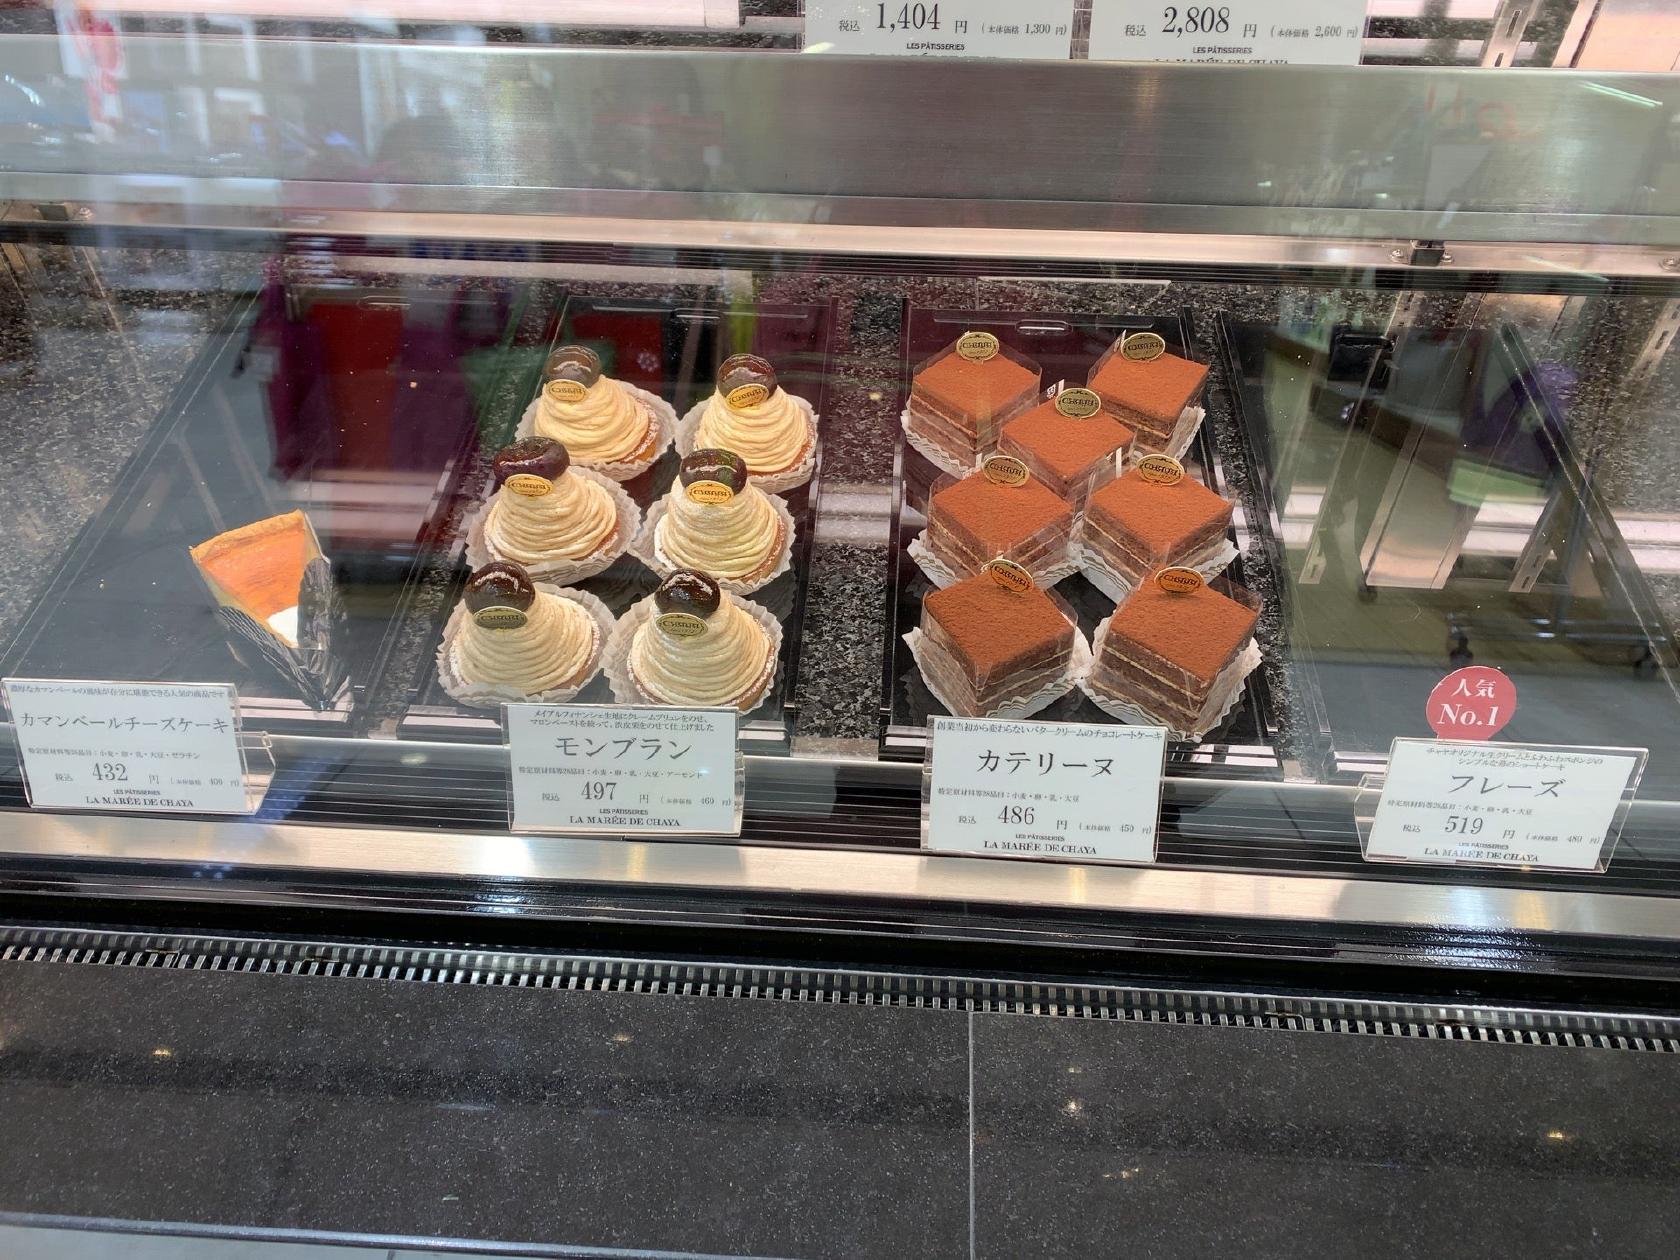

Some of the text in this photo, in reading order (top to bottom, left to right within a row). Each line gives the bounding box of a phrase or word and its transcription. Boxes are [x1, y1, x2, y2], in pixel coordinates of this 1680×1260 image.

[839, 19, 860, 32] 税込
[876, 2, 941, 33] 1,404
[955, 20, 968, 34] 円
[1025, 23, 1051, 34] 1,300
[1124, 24, 1147, 37] 税込
[1162, 6, 1230, 38] 2,808
[1243, 24, 1257, 39] 円
[1314, 26, 1342, 38] 2,600
[906, 42, 965, 52] LES PÂTISSERIES
[1193, 45, 1253, 54] LES PÂTISSERIES
[1451, 679, 1496, 698] 人気
[21, 712, 229, 734] カマンベールチーズケーキ
[1436, 704, 1499, 726] No.1
[556, 737, 692, 760] モンブラン
[92, 763, 128, 781] 432
[976, 750, 1114, 777] カテリーヌ
[581, 781, 617, 801] 497
[1449, 775, 1566, 798] フレーズ
[86, 796, 193, 807] LA MARÉE DE CHAYA
[569, 815, 680, 826] LA MARÉE DE CHAYA
[997, 806, 1035, 825] 486
[1056, 820, 1067, 830] 円
[1444, 816, 1484, 835] 519
[1503, 830, 1515, 839] 円
[984, 841, 1097, 855] LA MARÉE DE CHAYA
[1424, 847, 1441, 856] LA
[1486, 851, 1501, 859] DE
[1503, 852, 1539, 863] CHAYA
